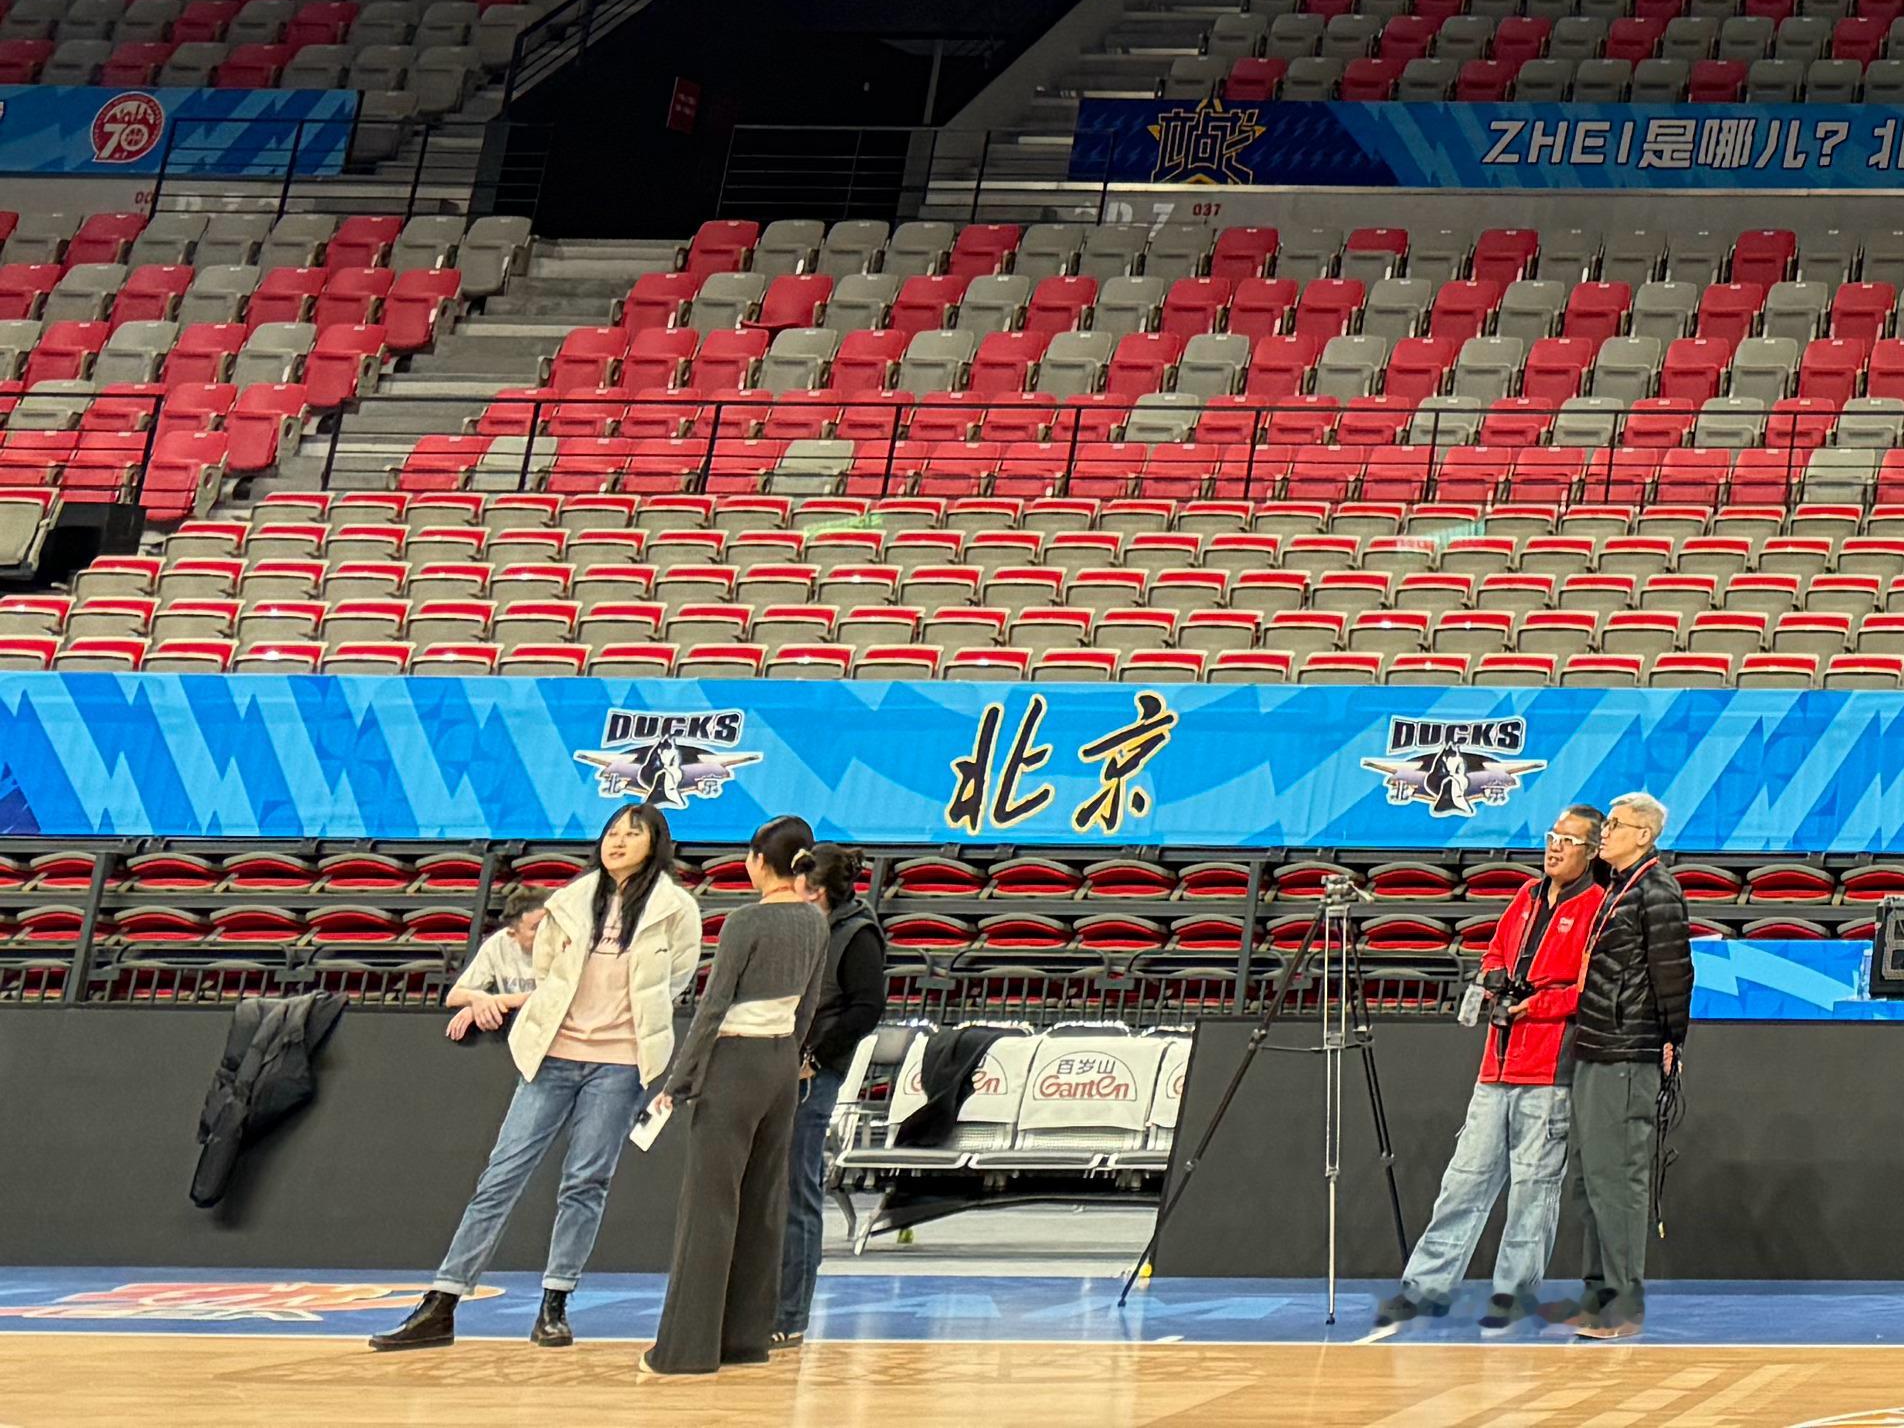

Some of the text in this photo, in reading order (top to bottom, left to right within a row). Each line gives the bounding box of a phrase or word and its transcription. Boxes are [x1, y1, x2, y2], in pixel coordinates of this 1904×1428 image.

[606, 713, 740, 742] DUCKS
[1392, 721, 1522, 749] DUCKS
[946, 691, 1178, 836] 北京
[1057, 1059, 1116, 1075] 百岁山
